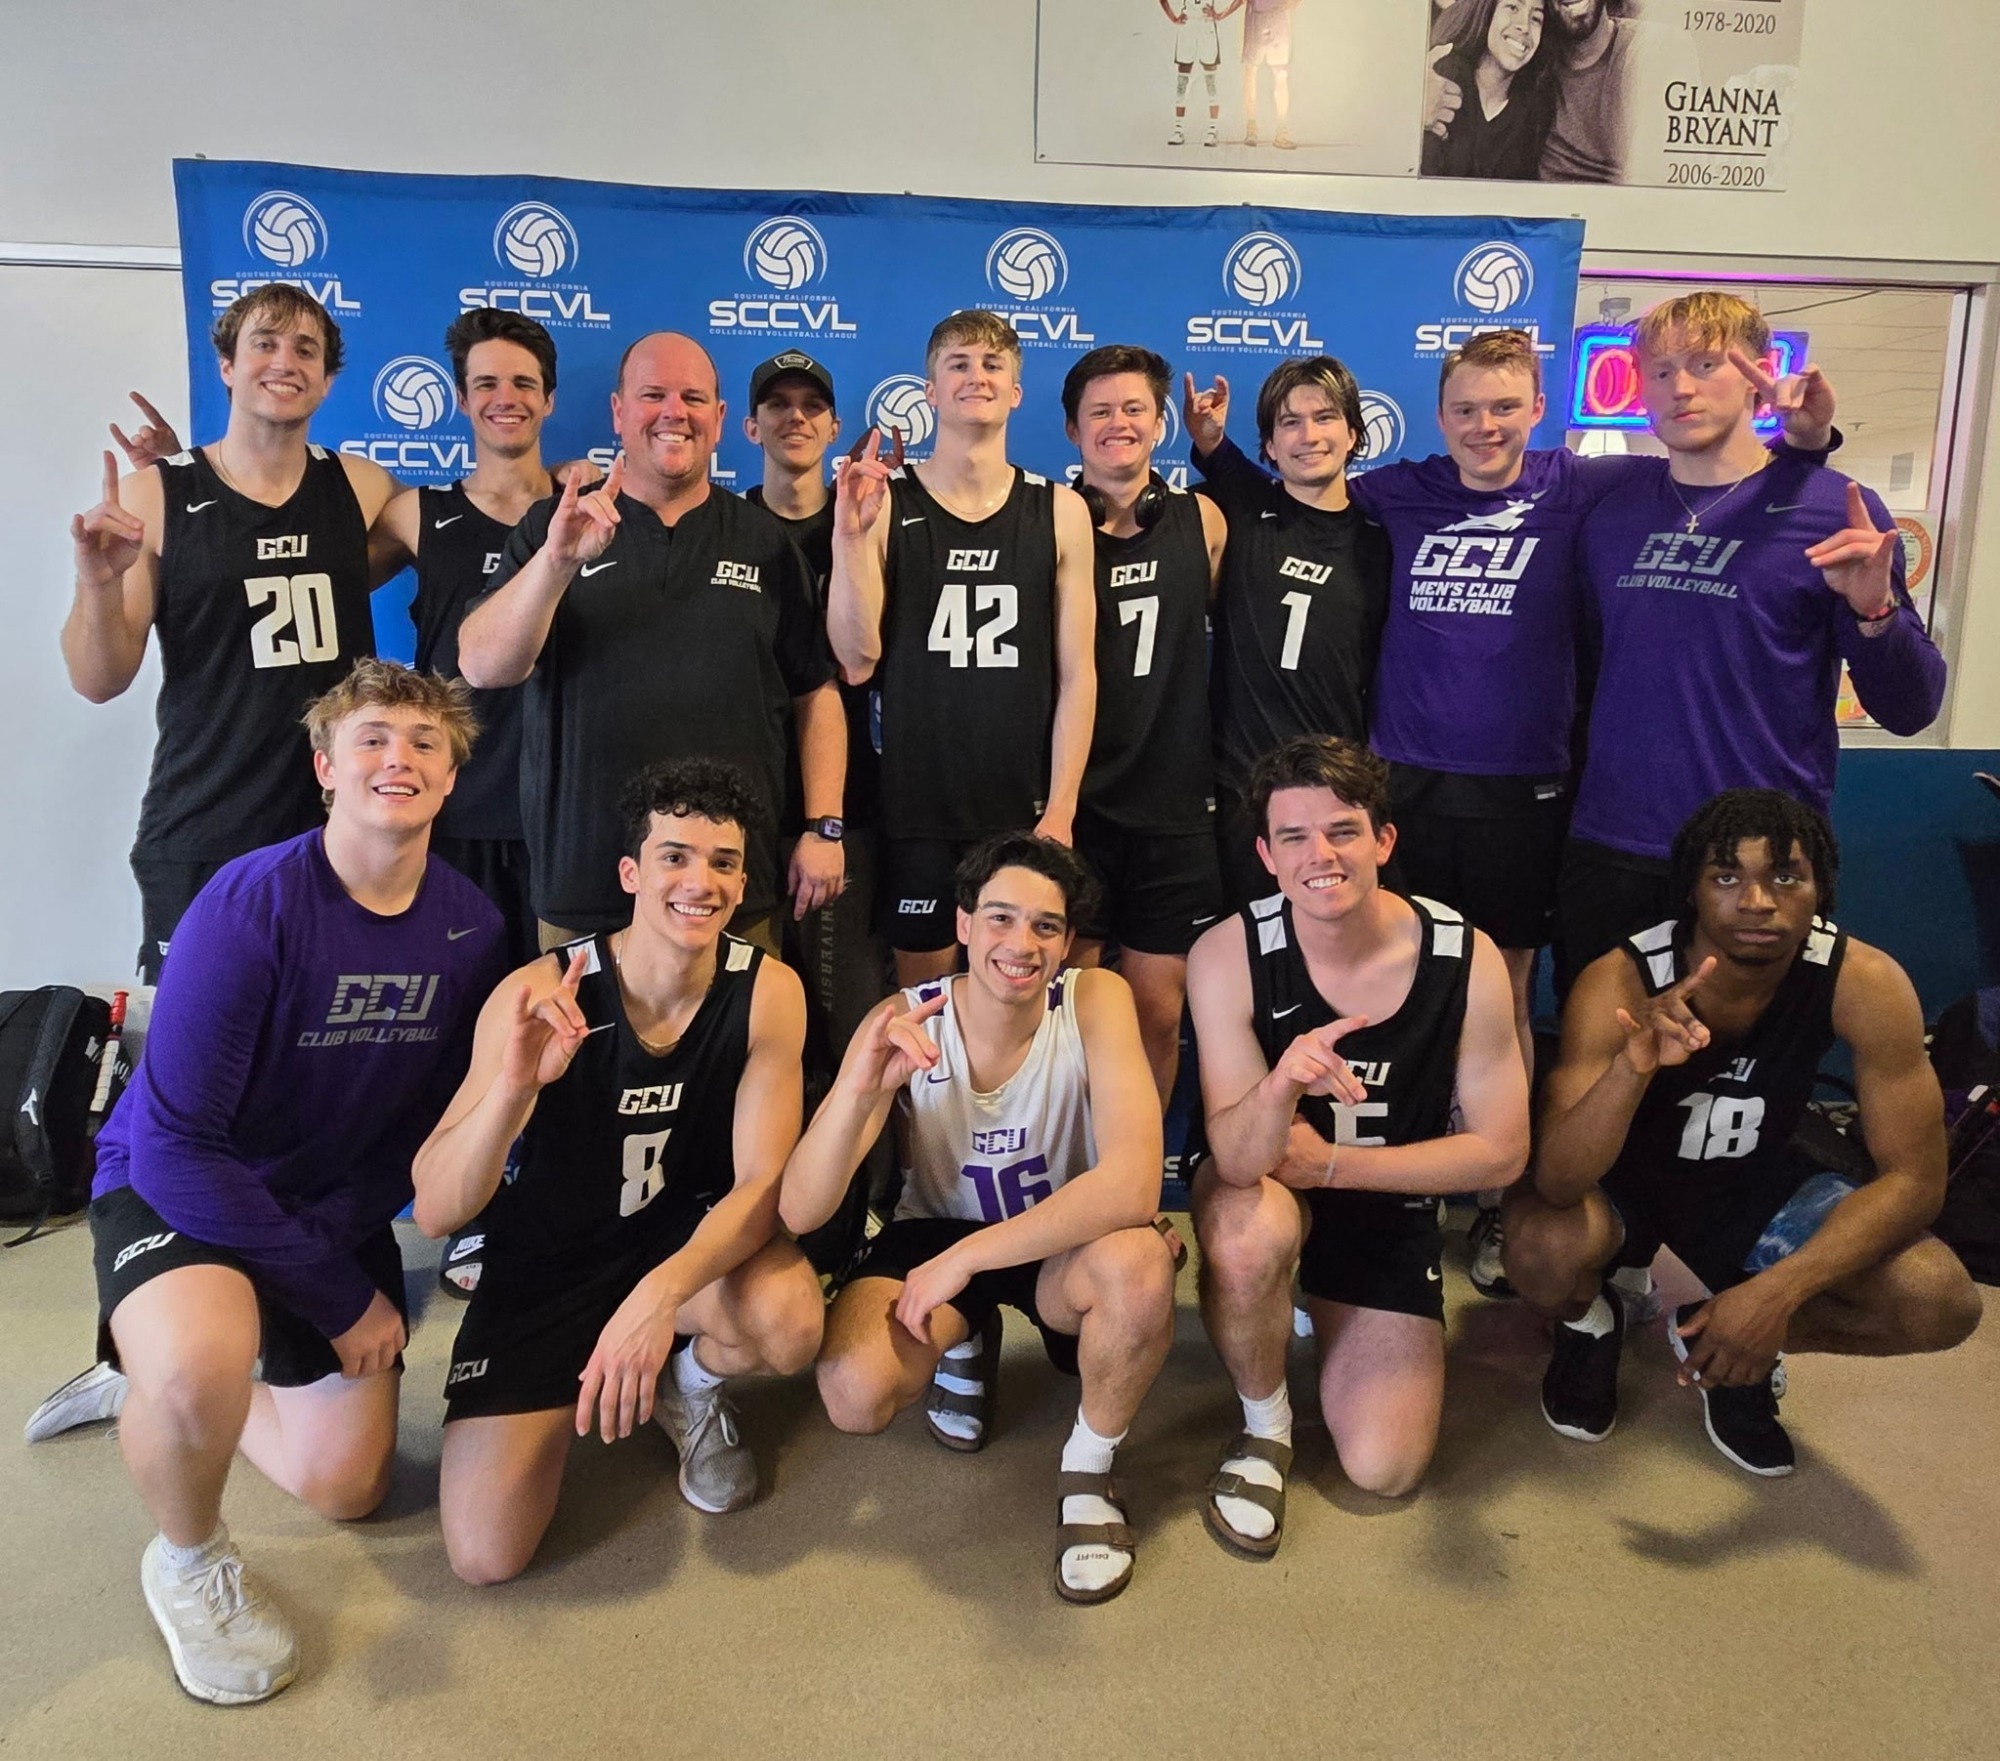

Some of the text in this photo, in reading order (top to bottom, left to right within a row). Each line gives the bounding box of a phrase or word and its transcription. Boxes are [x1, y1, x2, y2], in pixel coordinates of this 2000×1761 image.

[1683, 10, 1776, 34] 1978-2020
[1665, 81, 1781, 115] GIANNA
[1666, 116, 1779, 148] BRYANT
[1667, 163, 1765, 187] 2006-2020
[484, 280, 589, 291] SOUTHERN CALIFORNIA
[784, 294, 837, 302] CALIFORNIA
[459, 288, 611, 321] SCCVL
[709, 300, 857, 331] SCCVL
[975, 303, 1076, 313] SOUTHERN CALIFORNIA
[1211, 309, 1307, 319] SOUTHERN CALIFORNIA
[577, 322, 612, 330] LEAGUE
[709, 328, 763, 336] COLLEGIATE
[766, 330, 821, 338] VOLLEYBALL
[951, 309, 1095, 341] CVL
[1187, 317, 1324, 348] SCCVL
[1062, 342, 1095, 350] LEAGUE
[1185, 345, 1324, 356] COLLEGIATE VOLLEYBALL LEAGUE
[396, 469, 451, 477] VOLLEYBALL
[256, 534, 309, 560] GCU
[946, 549, 1000, 571] GCU
[1410, 534, 1541, 580] GCU
[1632, 532, 1744, 575] GCU
[715, 560, 760, 583] GCU
[1110, 560, 1158, 588] GCU
[1279, 555, 1334, 585] GCU
[1411, 580, 1517, 600] MEN'S CLUB
[1616, 575, 1739, 599] CLUB VOLLEYBALL
[1409, 595, 1513, 616] VOLLEYBALL
[243, 572, 339, 669] 20
[927, 584, 1019, 668] 42
[1280, 590, 1312, 670] 1
[1118, 595, 1160, 677] 7
[898, 899, 938, 914] GCU
[325, 974, 441, 1024] GCU
[297, 1026, 440, 1047] CLUB VOLLEYBALL
[1343, 1060, 1392, 1087] CU
[618, 1082, 684, 1115] GCU
[1677, 1092, 1766, 1160] 18
[971, 1127, 1028, 1155] GCU
[619, 1128, 673, 1217] 8
[113, 1231, 178, 1273] GCU
